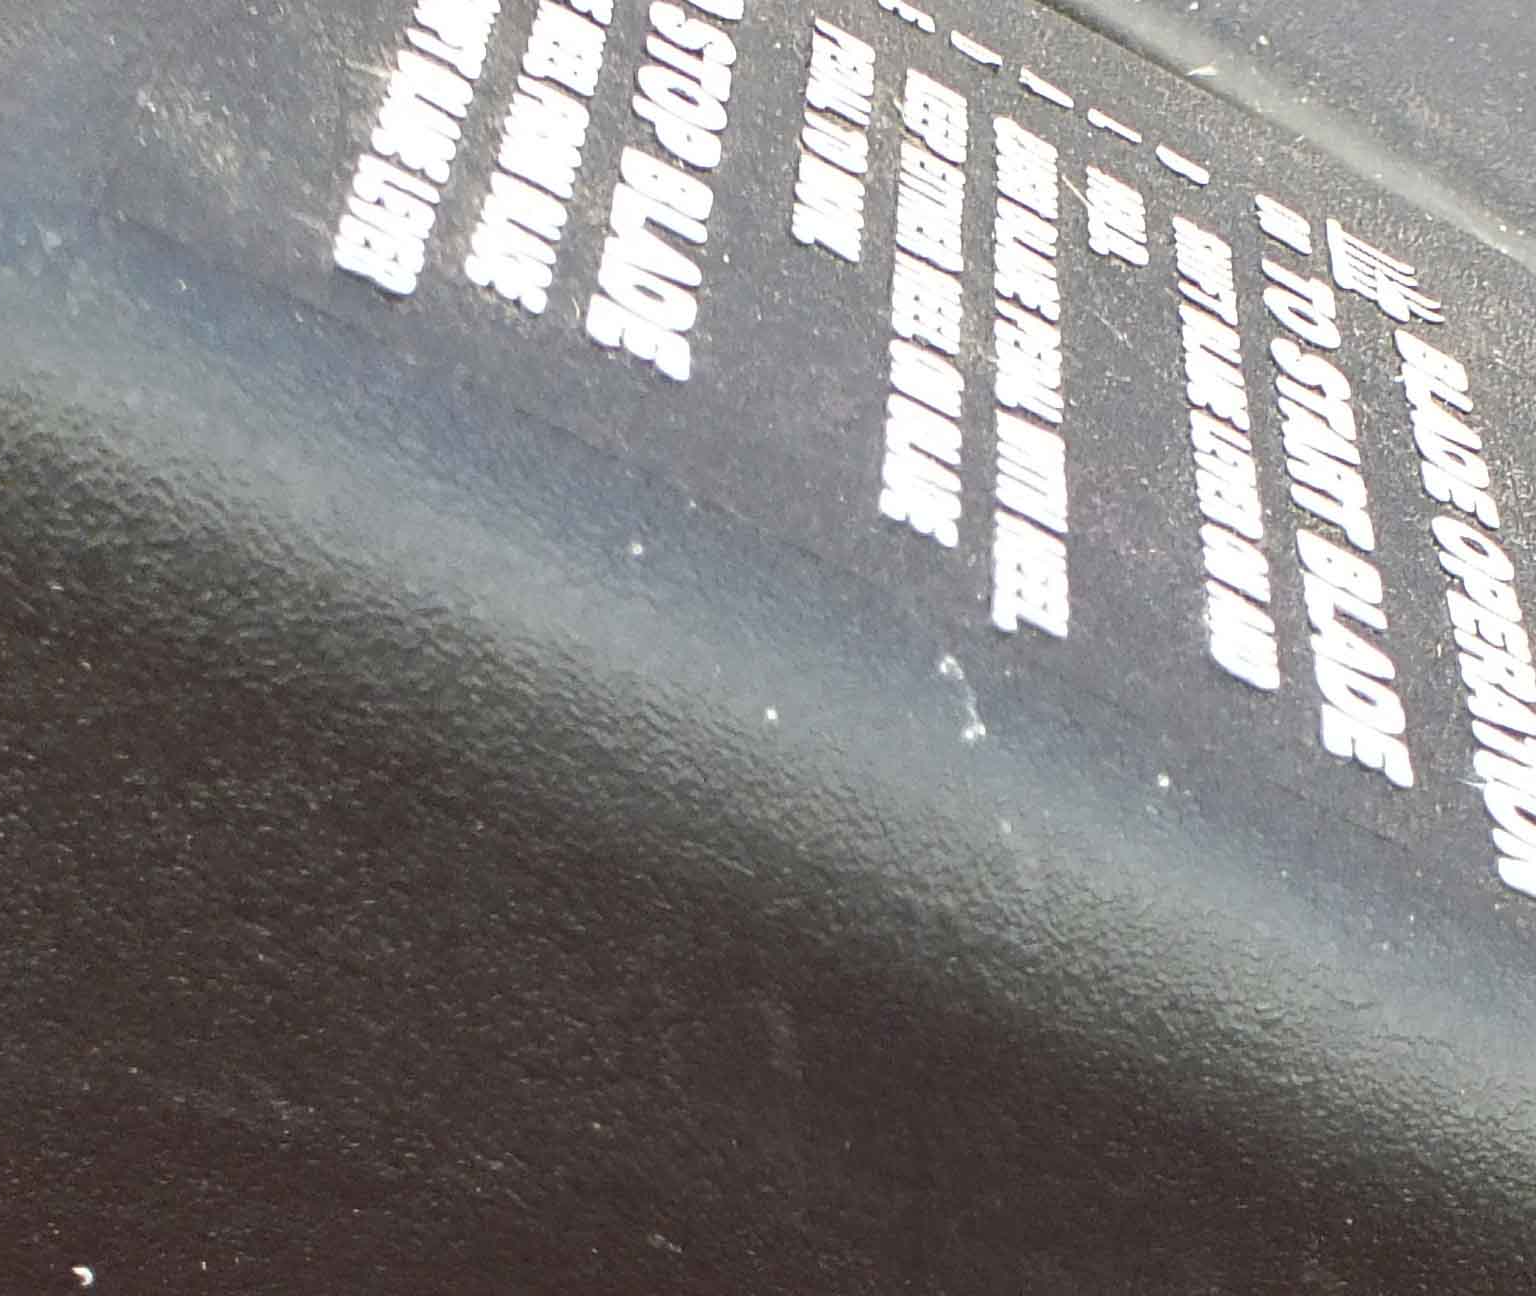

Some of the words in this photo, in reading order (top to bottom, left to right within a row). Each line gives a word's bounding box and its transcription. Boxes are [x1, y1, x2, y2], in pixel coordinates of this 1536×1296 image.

[630, 0, 738, 171] STOP
[586, 146, 713, 382] BLADE
[1261, 257, 1342, 350] TO
[1270, 338, 1376, 552] START
[1395, 327, 1500, 530] BLADE
[1296, 528, 1414, 788] BLADE
